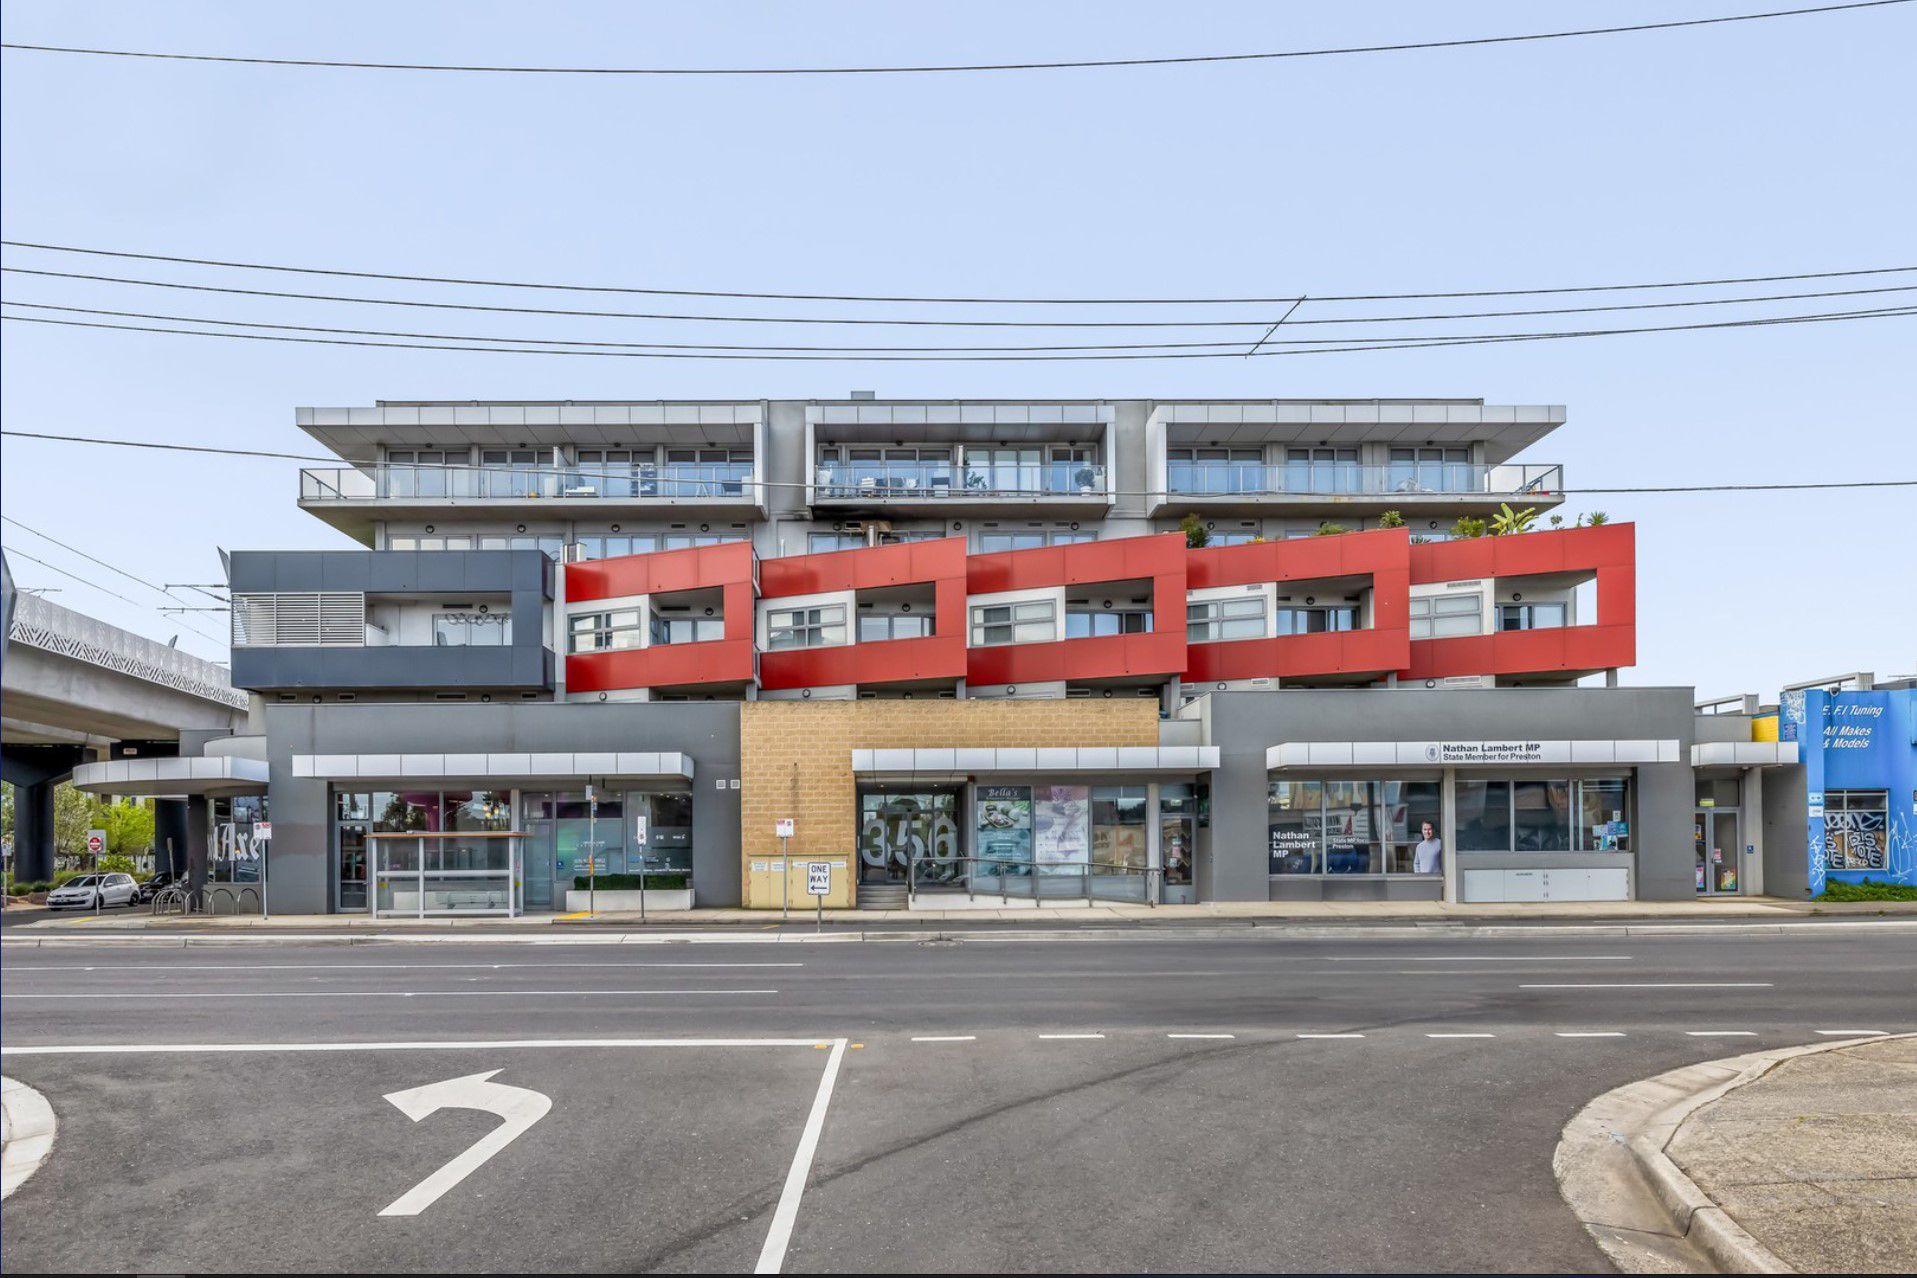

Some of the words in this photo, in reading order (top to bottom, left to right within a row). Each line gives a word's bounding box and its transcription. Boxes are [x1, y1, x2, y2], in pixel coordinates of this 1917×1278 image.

[1849, 704, 1884, 718] Tuning
[1823, 725, 1839, 736] All
[1839, 725, 1873, 736] Makes
[1443, 744, 1478, 752] Nathan
[1481, 744, 1522, 752] Lambert
[1525, 743, 1541, 752] MP
[1823, 738, 1831, 749] &
[1832, 737, 1871, 749] Models
[1443, 753, 1463, 761] State
[1465, 753, 1498, 761] Member
[1510, 752, 1541, 760] Preston
[988, 787, 1018, 797] Bella's
[1272, 831, 1309, 840] Nathan
[861, 815, 958, 867] 356
[1273, 840, 1316, 849] Lambert
[1272, 849, 1289, 858] MP
[811, 864, 827, 873] ONE
[810, 875, 828, 883] WAY
